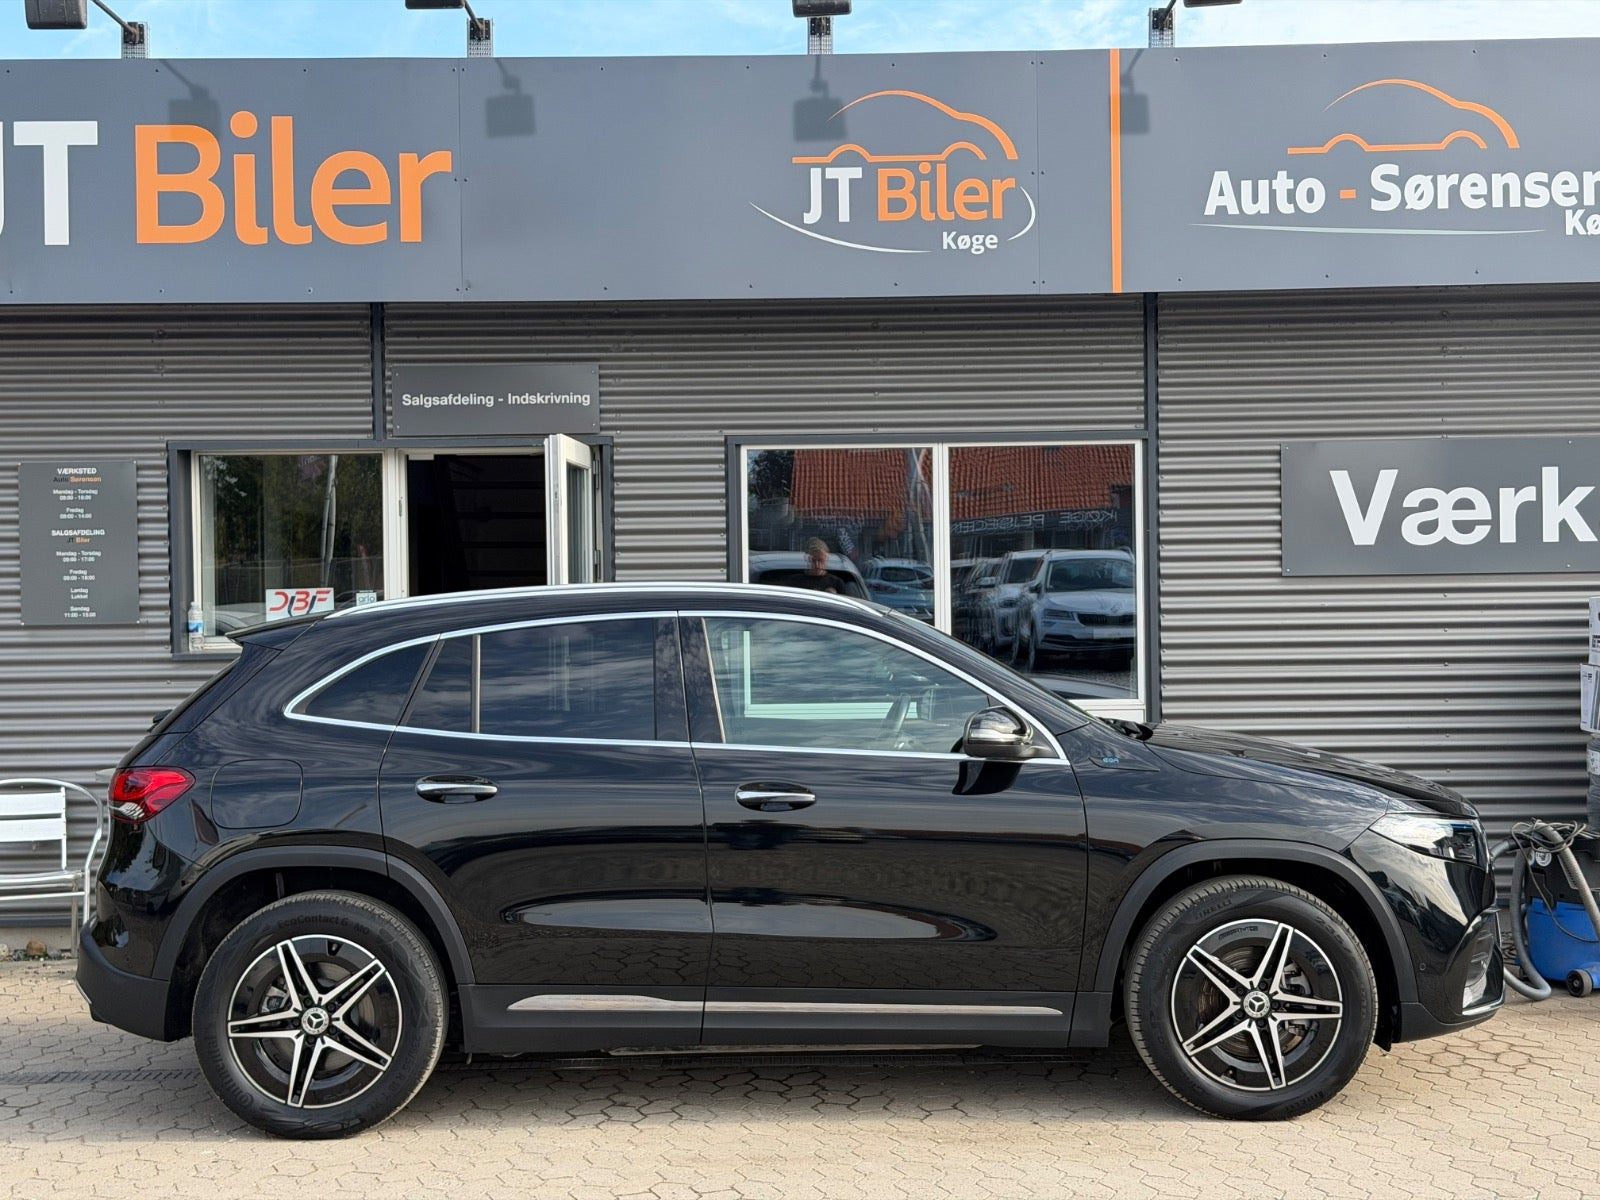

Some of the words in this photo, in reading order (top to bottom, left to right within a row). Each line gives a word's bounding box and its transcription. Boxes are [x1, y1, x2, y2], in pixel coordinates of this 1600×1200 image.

[0, 121, 98, 246] T
[135, 110, 452, 245] Biler
[803, 166, 863, 224] JT
[877, 161, 1016, 222] Biler
[1204, 170, 1326, 216] Auto
[942, 231, 998, 255] Køge
[402, 393, 495, 408] Salgsafdeling
[508, 392, 591, 406] Indskrivning
[56, 467, 97, 475] VÆRKSTED
[77, 488, 98, 496] Torsdag
[1329, 466, 1599, 546] Værk
[269, 589, 331, 613] DBF
